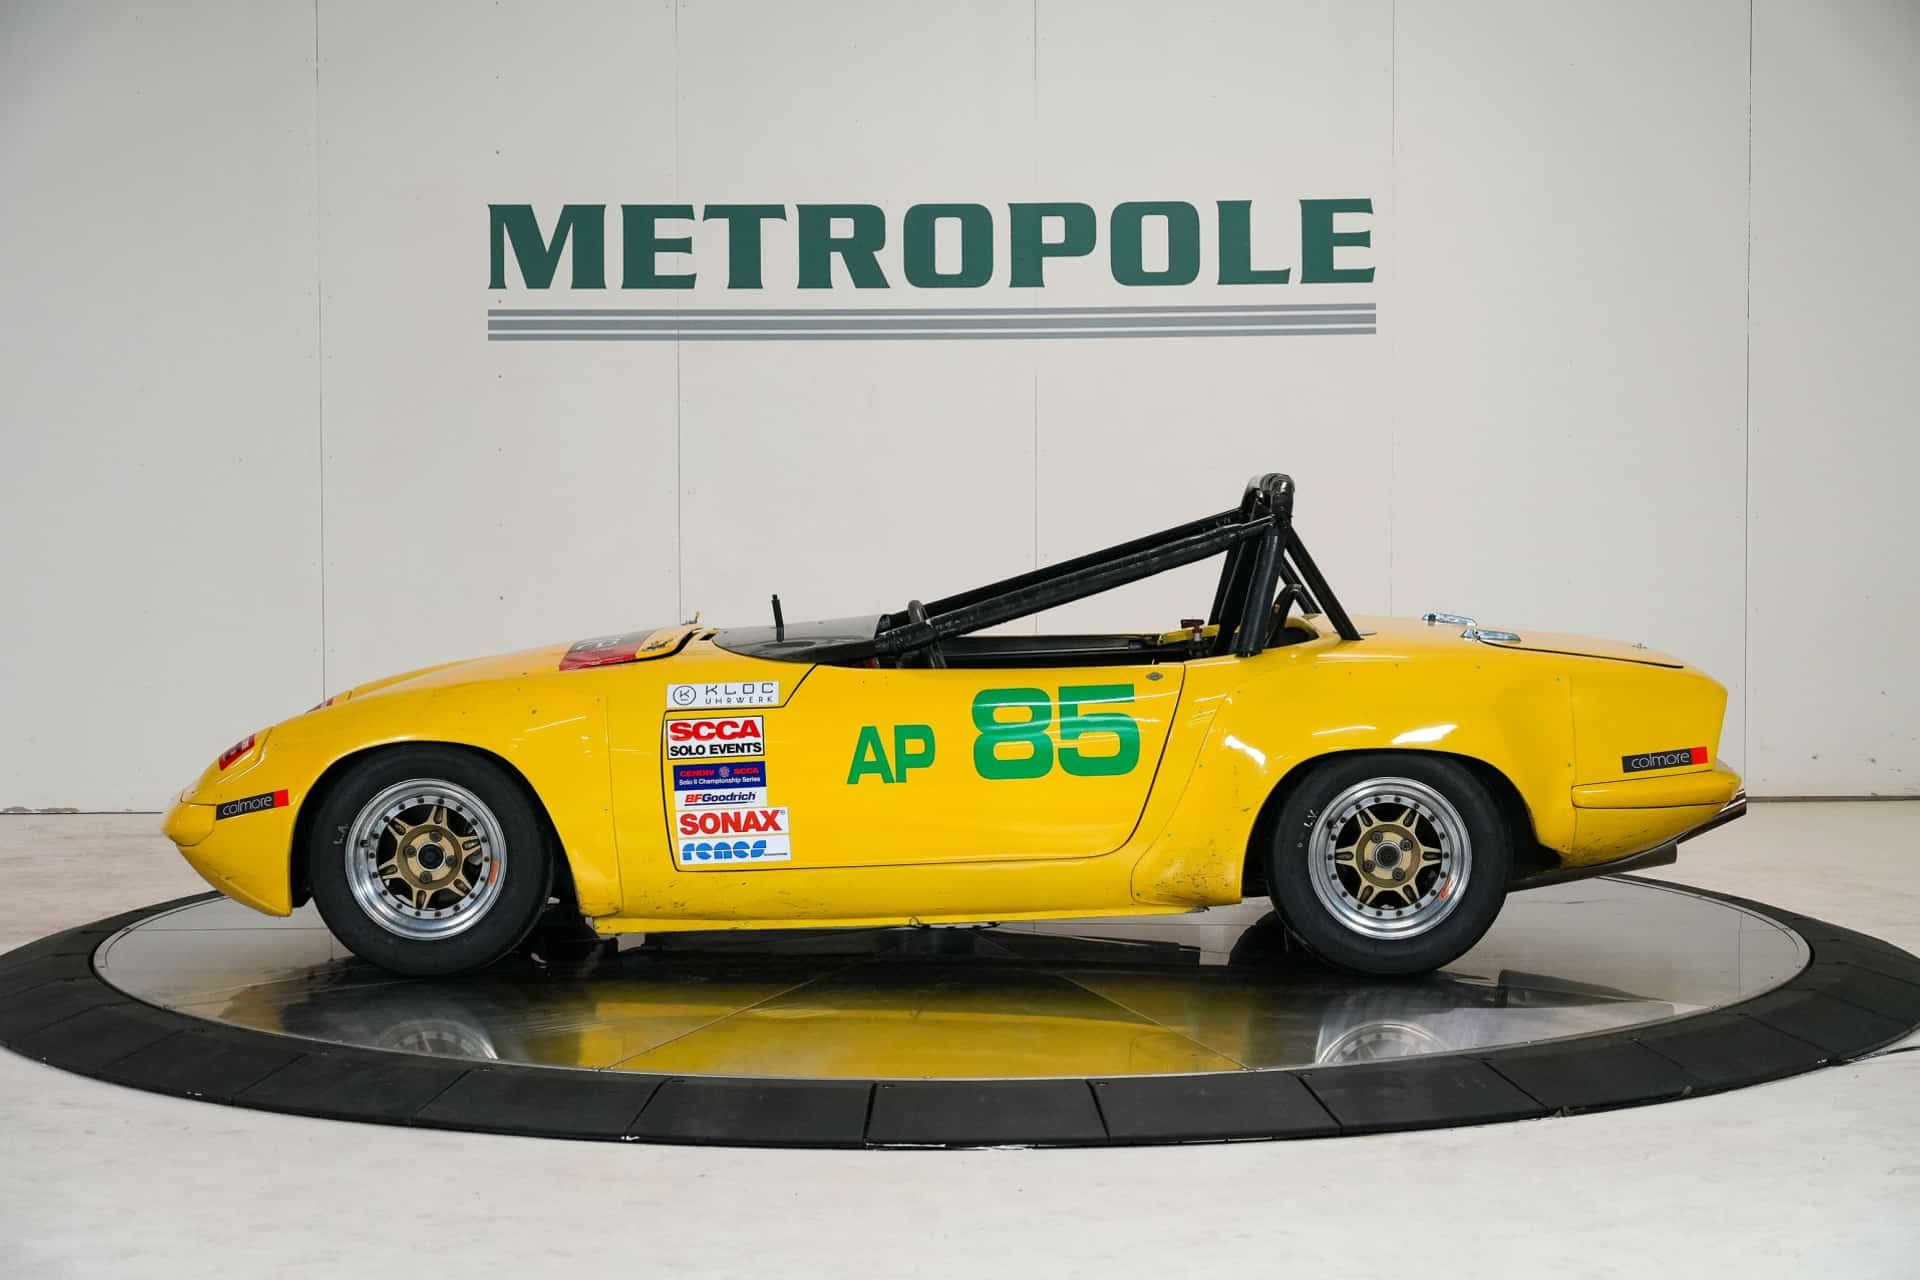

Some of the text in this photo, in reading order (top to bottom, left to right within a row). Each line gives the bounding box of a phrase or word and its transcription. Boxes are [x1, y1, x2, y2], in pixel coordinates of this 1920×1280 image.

[487, 198, 1376, 290] METROPOLE
[705, 682, 774, 695] KLOC
[705, 696, 773, 704] UHRWERK
[669, 719, 760, 741] SCCA
[847, 684, 1140, 784] AP 85
[670, 742, 762, 757] SOLO EVENTS
[1631, 752, 1690, 769] colmore
[733, 767, 760, 775] SCCA
[222, 795, 273, 816] colmore
[685, 792, 757, 803] BFGoodrich
[679, 809, 783, 835] SONAX
